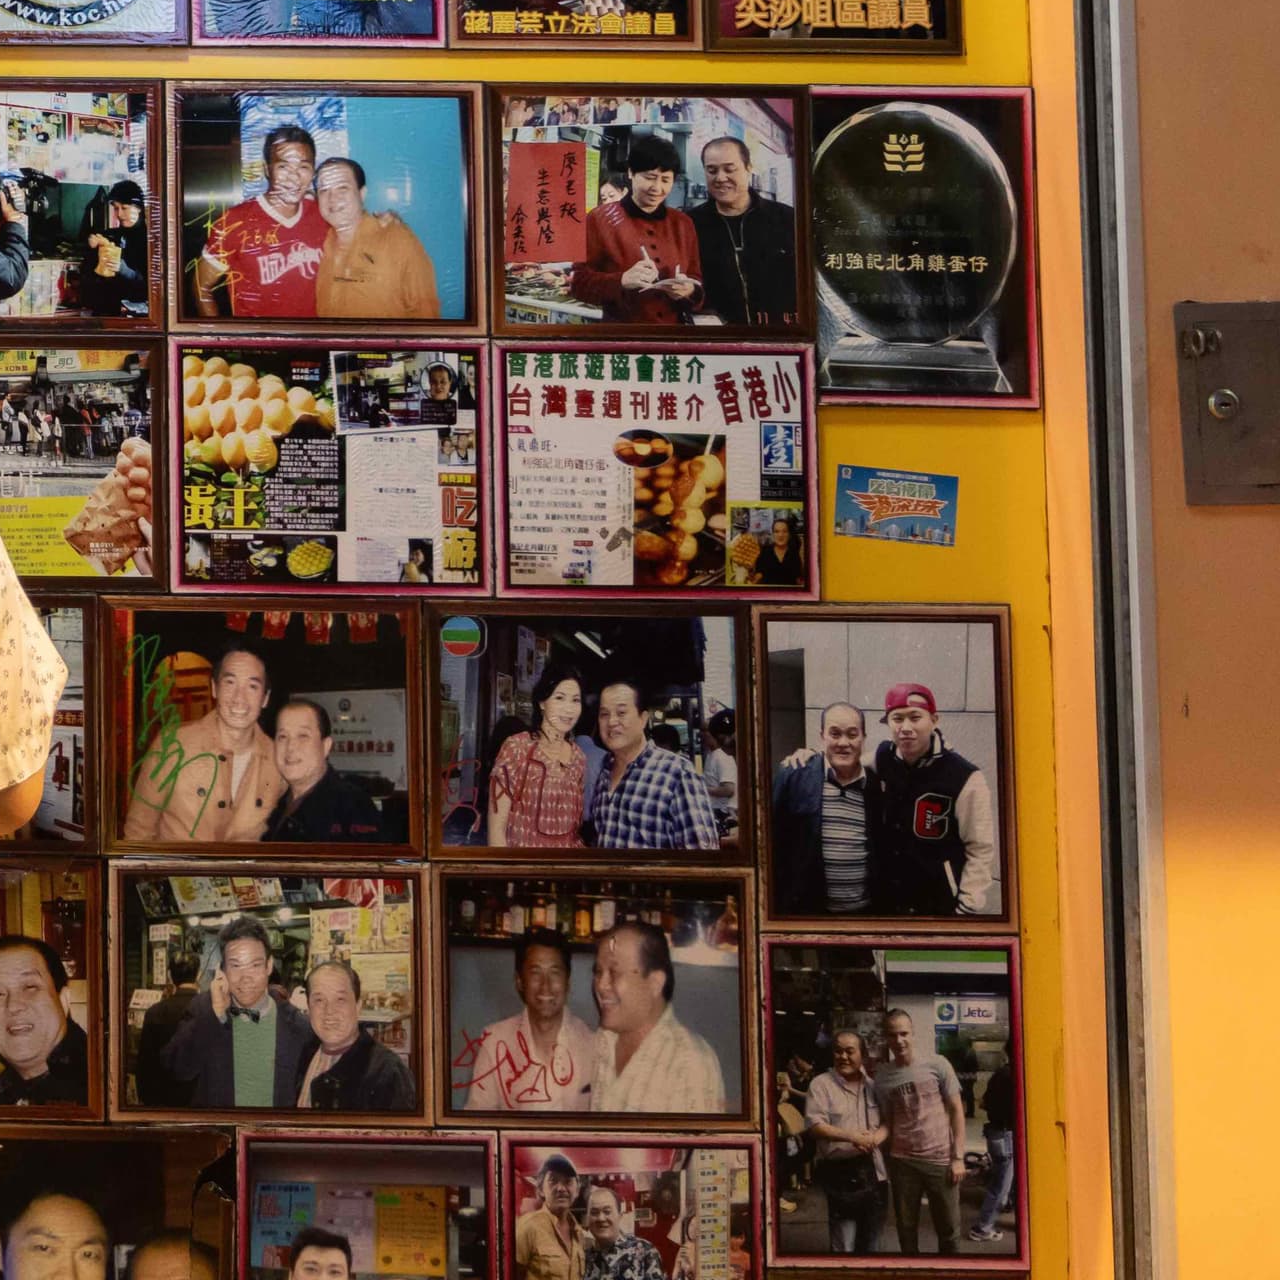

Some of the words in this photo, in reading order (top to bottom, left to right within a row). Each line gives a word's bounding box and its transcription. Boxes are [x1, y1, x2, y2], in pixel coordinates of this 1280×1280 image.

[825, 252, 989, 273] 利強記北角雞蛋仔
[508, 383, 705, 422] 台灣壹週刊推介
[714, 360, 801, 426] 香港小
[184, 485, 261, 530] 蛋王
